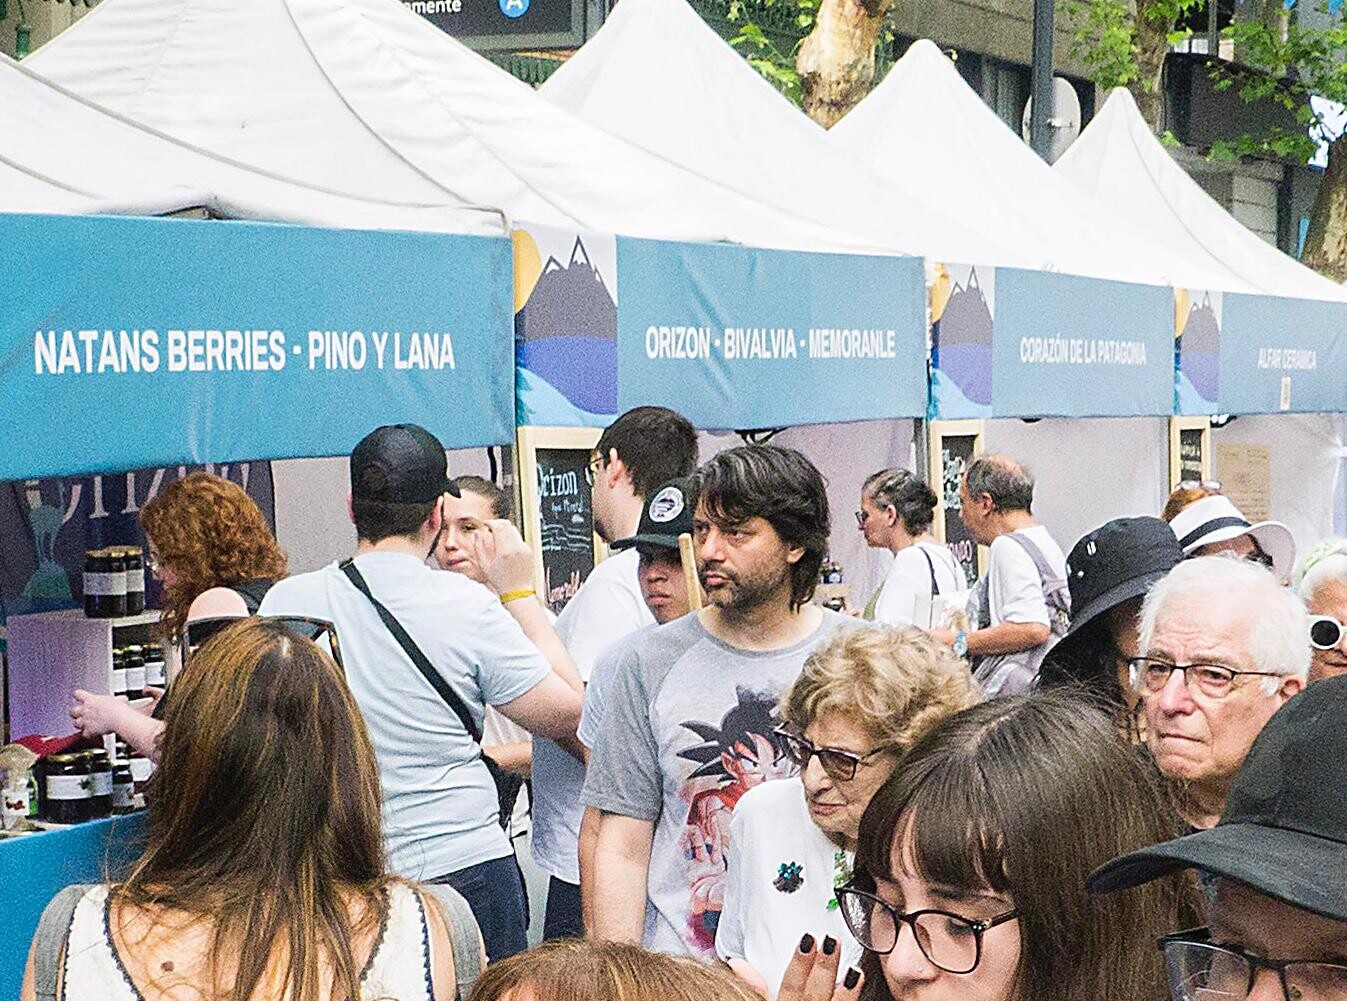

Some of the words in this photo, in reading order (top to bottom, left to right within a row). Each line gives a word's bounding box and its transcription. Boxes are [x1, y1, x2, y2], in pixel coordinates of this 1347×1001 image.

[34, 330, 159, 374] NATANS
[168, 330, 286, 372] BERRIES
[308, 331, 366, 370] PINO
[371, 332, 388, 369] Y
[394, 333, 456, 369] LANA
[645, 326, 711, 359] ORIZON
[724, 328, 798, 359] BIVALVIA
[809, 329, 896, 358] MEMORANLE
[1020, 333, 1068, 363] CORAZÓN
[1069, 339, 1082, 364] DE
[1084, 339, 1096, 364] LA
[1099, 340, 1147, 365] PATAGONIA
